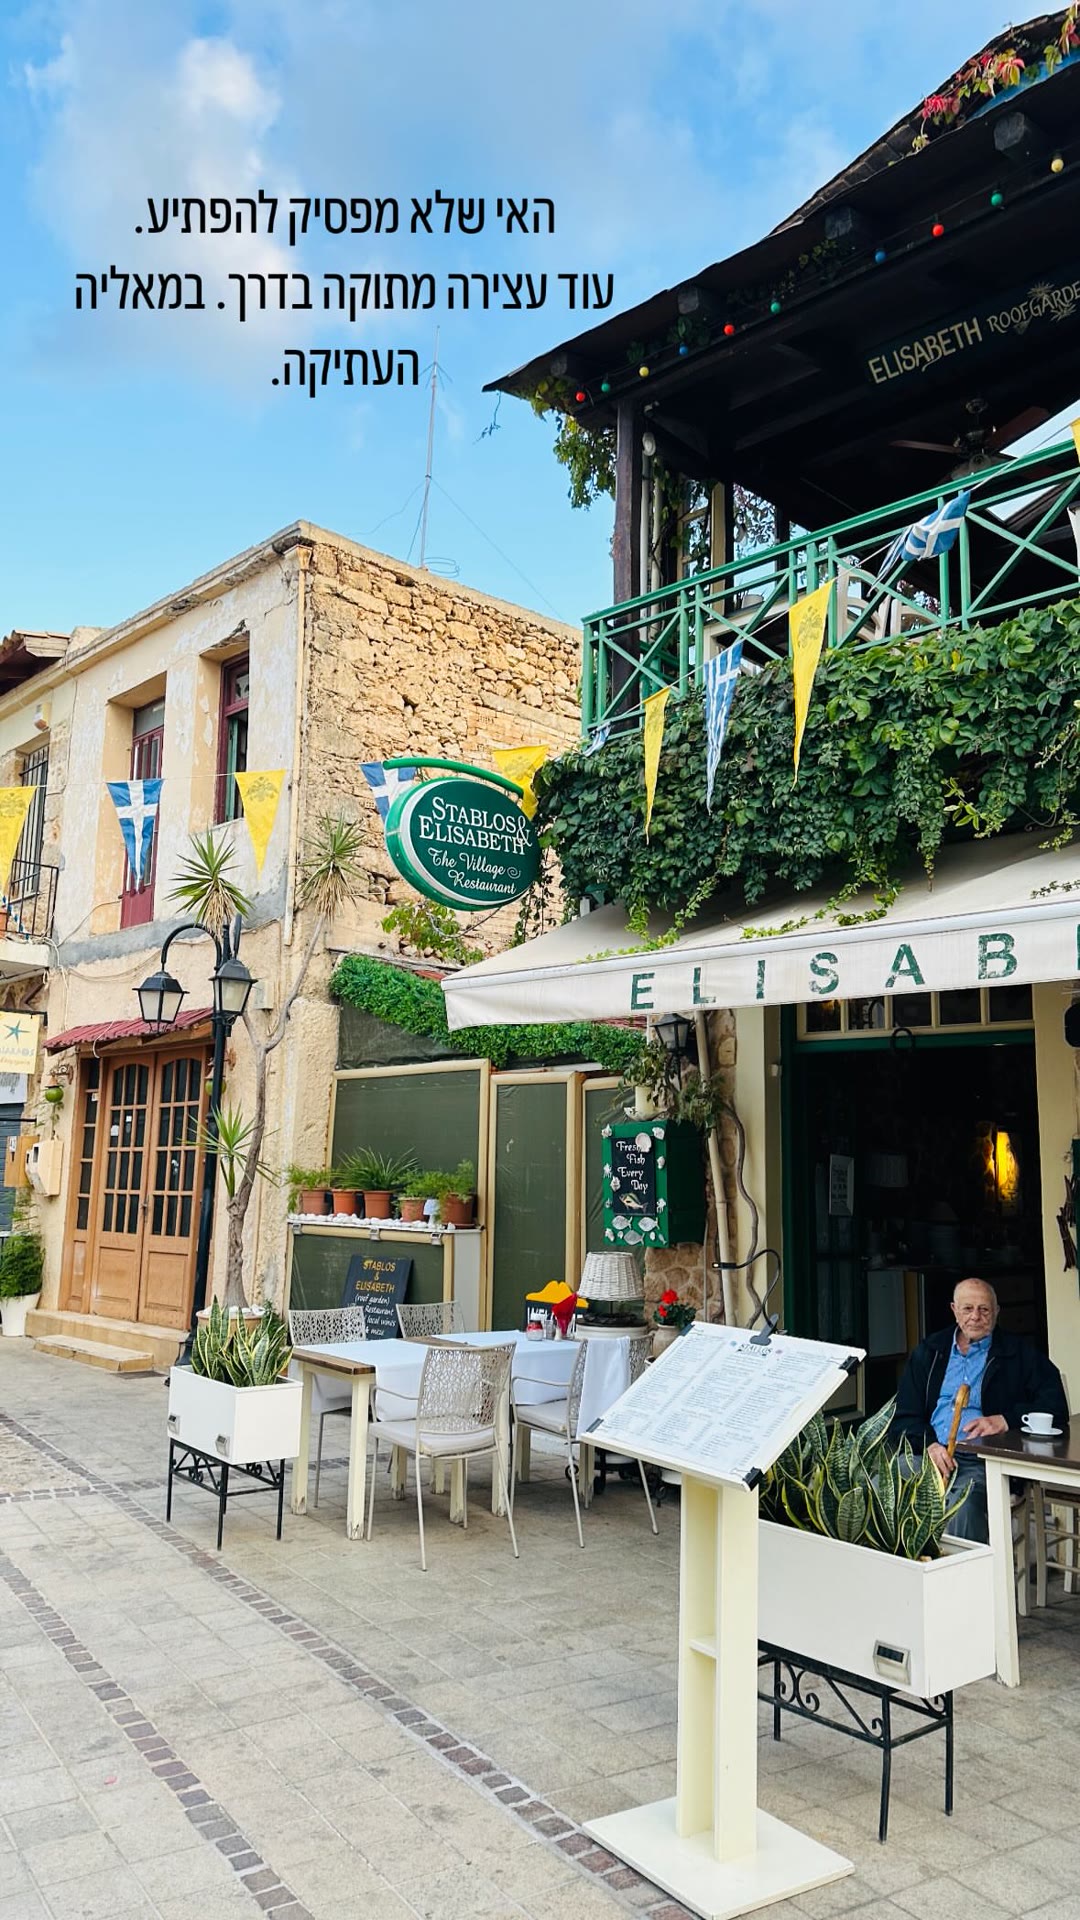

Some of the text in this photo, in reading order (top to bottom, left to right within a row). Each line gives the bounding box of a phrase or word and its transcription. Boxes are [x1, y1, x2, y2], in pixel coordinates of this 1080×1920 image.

[868, 317, 983, 384] ELISABETH
[432, 796, 516, 834] STABLOS
[418, 814, 526, 856] ELISABETH
[427, 846, 506, 880] The Village
[448, 869, 517, 896] Restaurant
[630, 923, 1080, 1010] ELISAB
[626, 1153, 646, 1166] Fish
[617, 1166, 644, 1181] Every
[630, 1179, 649, 1195] Day
[363, 1260, 397, 1272] STABLOS
[355, 1280, 395, 1293] ELISABETH
